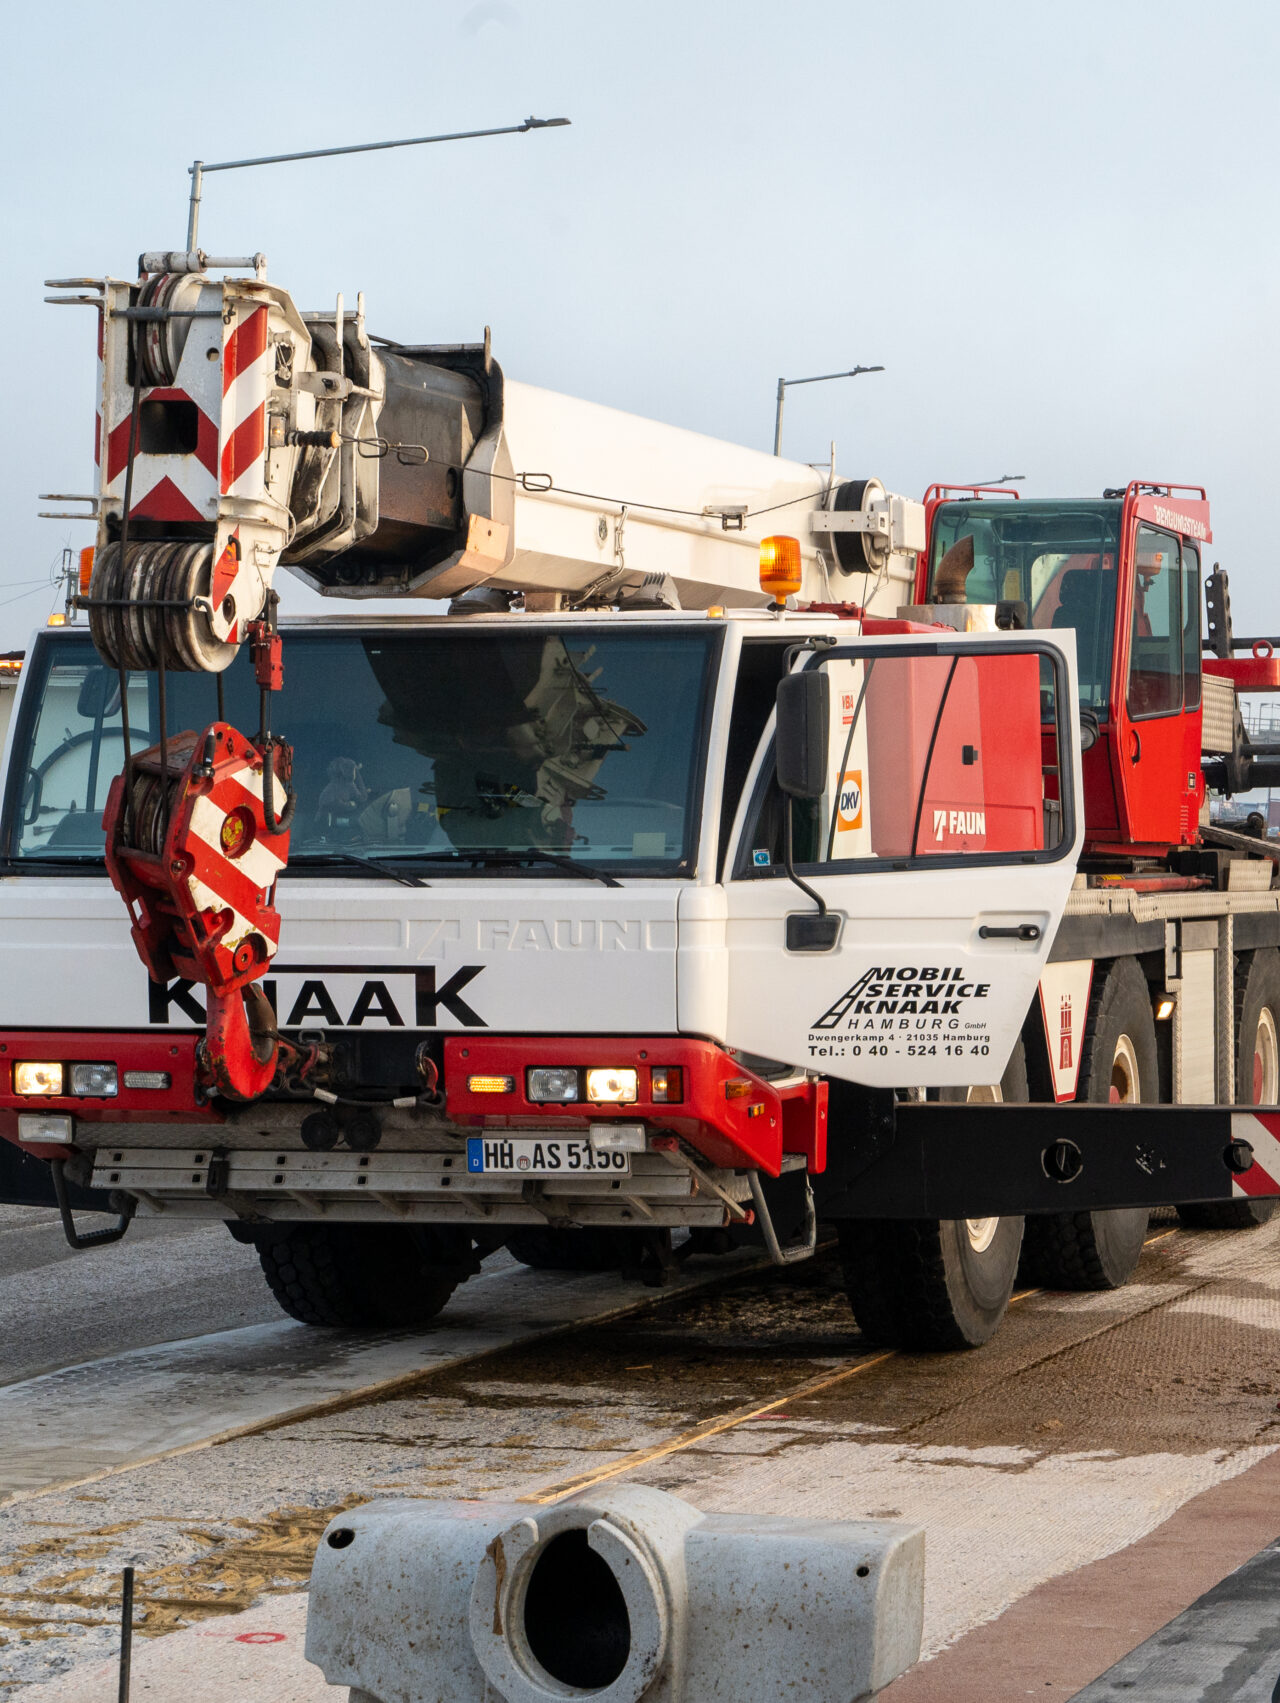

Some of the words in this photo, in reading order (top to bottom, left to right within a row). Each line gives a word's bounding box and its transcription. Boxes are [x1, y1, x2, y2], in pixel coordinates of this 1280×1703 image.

[840, 790, 860, 811] DKV
[949, 812, 986, 836] FAUN
[477, 920, 642, 950] FAUN
[873, 967, 966, 981] MOBIL
[865, 984, 991, 998] SERVICE
[853, 1000, 964, 1014] KNAAK
[848, 1018, 960, 1030] HAMBURG
[964, 1022, 987, 1030] GmbH
[808, 1034, 885, 1042] Dwengerkamp
[943, 1034, 991, 1043] Hamburg
[808, 1045, 846, 1056] Tel.:
[853, 1045, 862, 1056] 0
[868, 1045, 888, 1056] 40
[907, 1045, 937, 1056] 524
[944, 1045, 963, 1056] 16
[970, 1045, 990, 1056] 40
[484, 1142, 514, 1169] HH
[532, 1142, 561, 1169] AS
